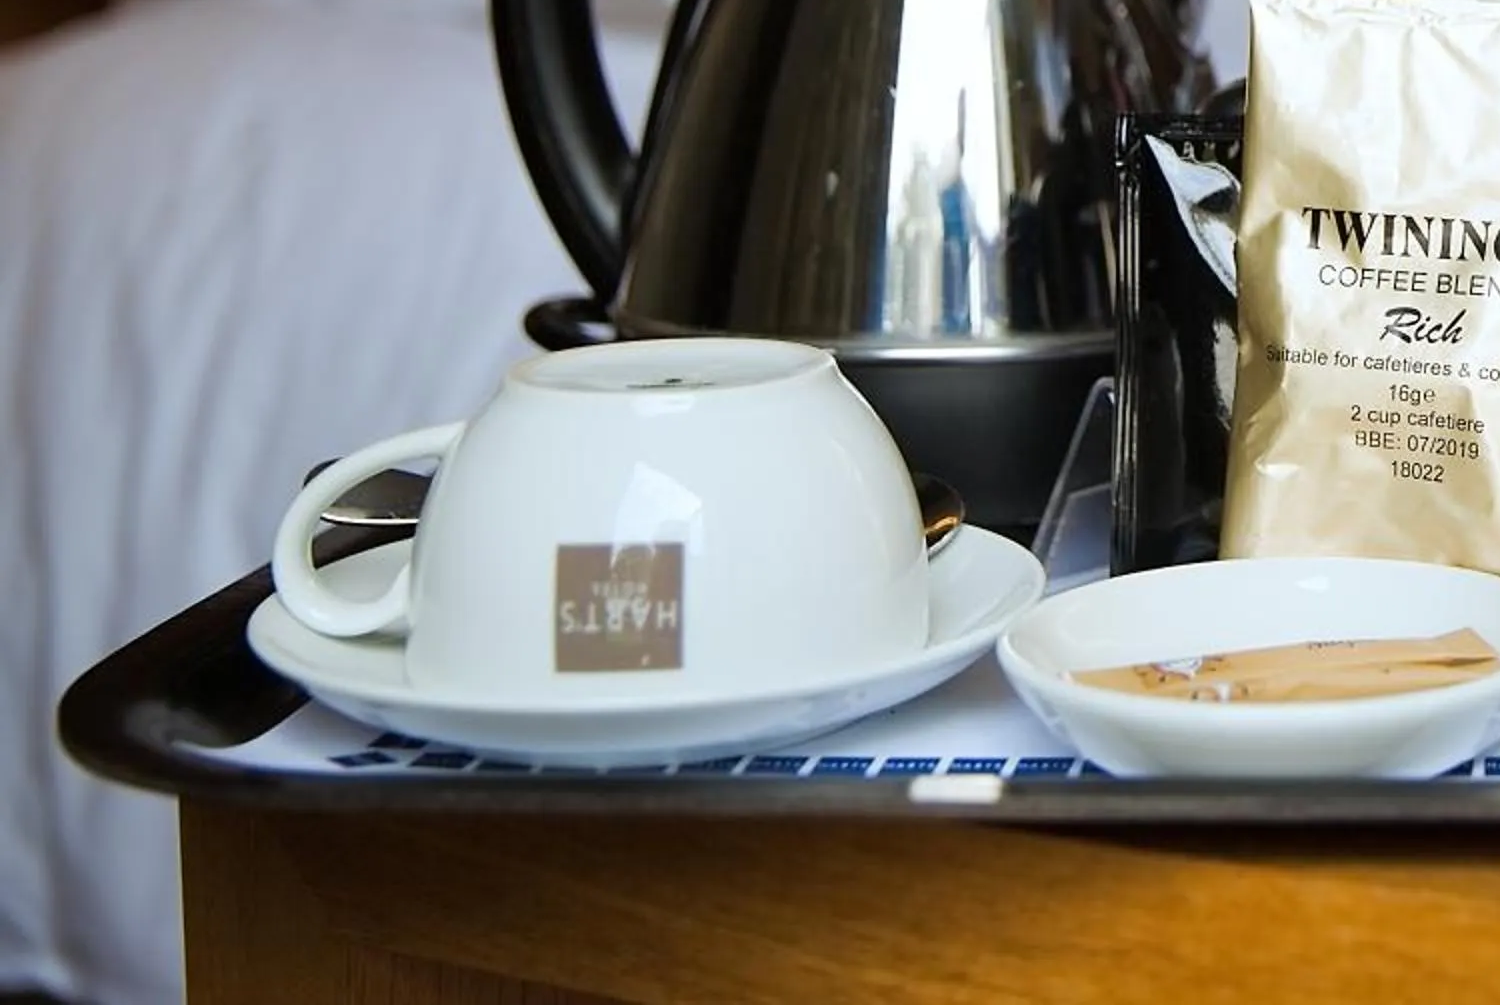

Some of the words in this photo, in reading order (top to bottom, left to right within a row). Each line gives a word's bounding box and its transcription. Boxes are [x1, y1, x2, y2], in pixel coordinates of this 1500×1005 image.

[1318, 263, 1427, 293] COFFEE
[1379, 306, 1468, 345] Rich
[1265, 344, 1330, 367] Suitable
[1333, 350, 1356, 369] for
[1363, 354, 1452, 377] cafetieres
[1458, 362, 1472, 378] &
[1350, 405, 1362, 422] 2
[1367, 410, 1401, 427] cup
[1406, 410, 1485, 434] cafetiere
[1355, 430, 1401, 450] BBE:
[1406, 435, 1481, 459] 07/2019
[1390, 460, 1445, 484] 18022
